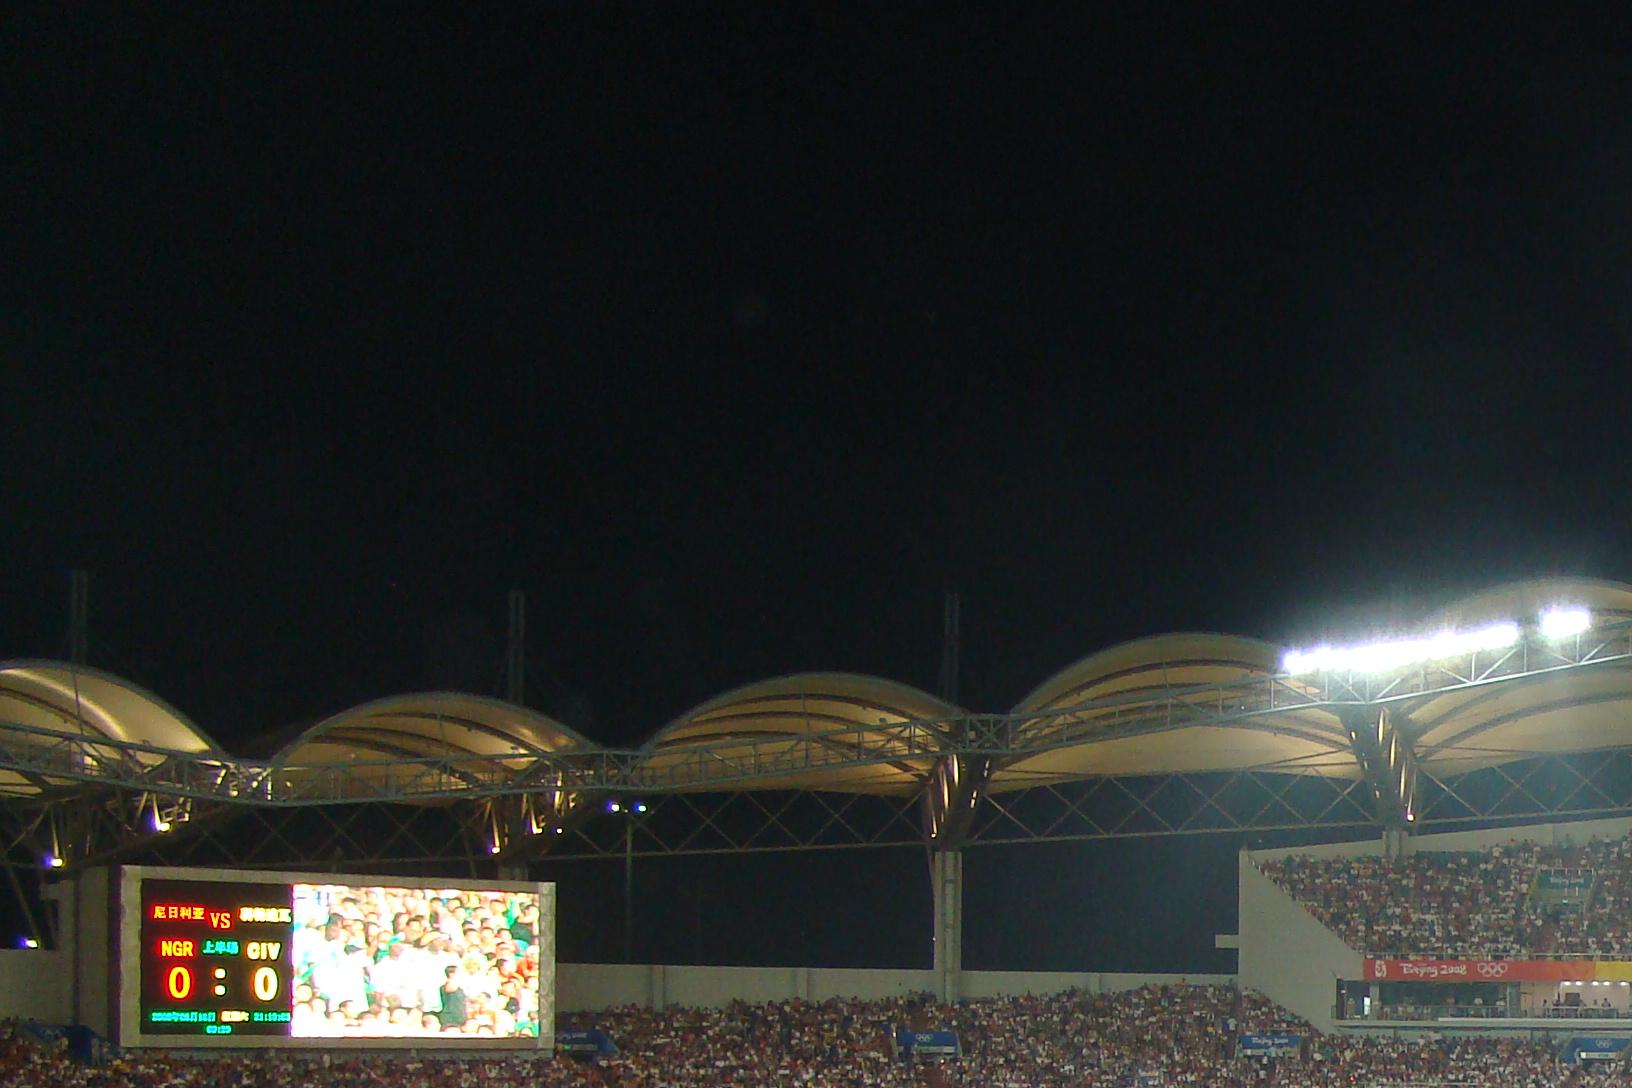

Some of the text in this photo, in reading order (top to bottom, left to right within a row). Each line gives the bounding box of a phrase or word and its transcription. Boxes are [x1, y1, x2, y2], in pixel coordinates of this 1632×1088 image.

[209, 912, 231, 929] VS
[161, 940, 193, 957] NGR
[1400, 963, 1438, 977] Beijing
[168, 966, 191, 999] 0
[254, 966, 278, 1001] 0
